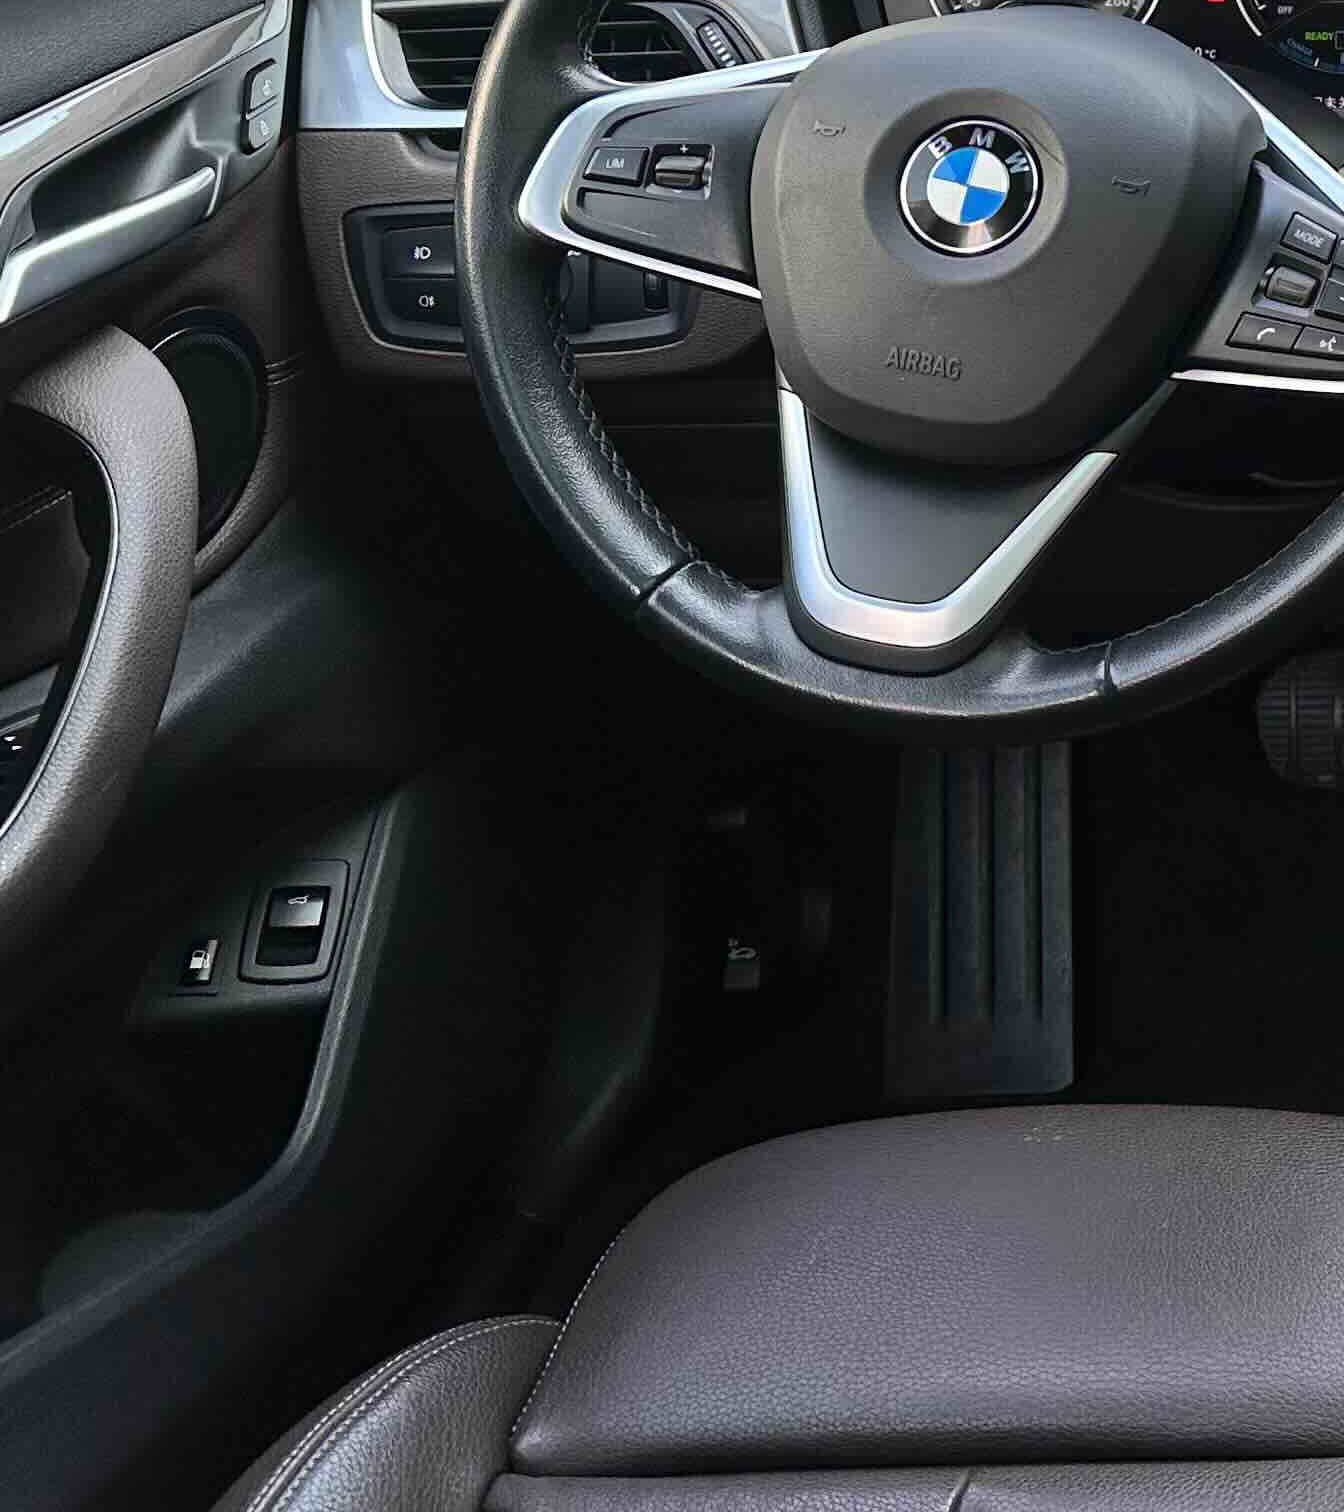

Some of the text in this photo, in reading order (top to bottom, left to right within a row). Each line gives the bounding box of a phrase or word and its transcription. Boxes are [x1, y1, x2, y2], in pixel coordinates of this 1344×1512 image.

[1304, 31, 1334, 41] READY
[927, 126, 1029, 174] BMW
[886, 346, 961, 381] AIRBAG
